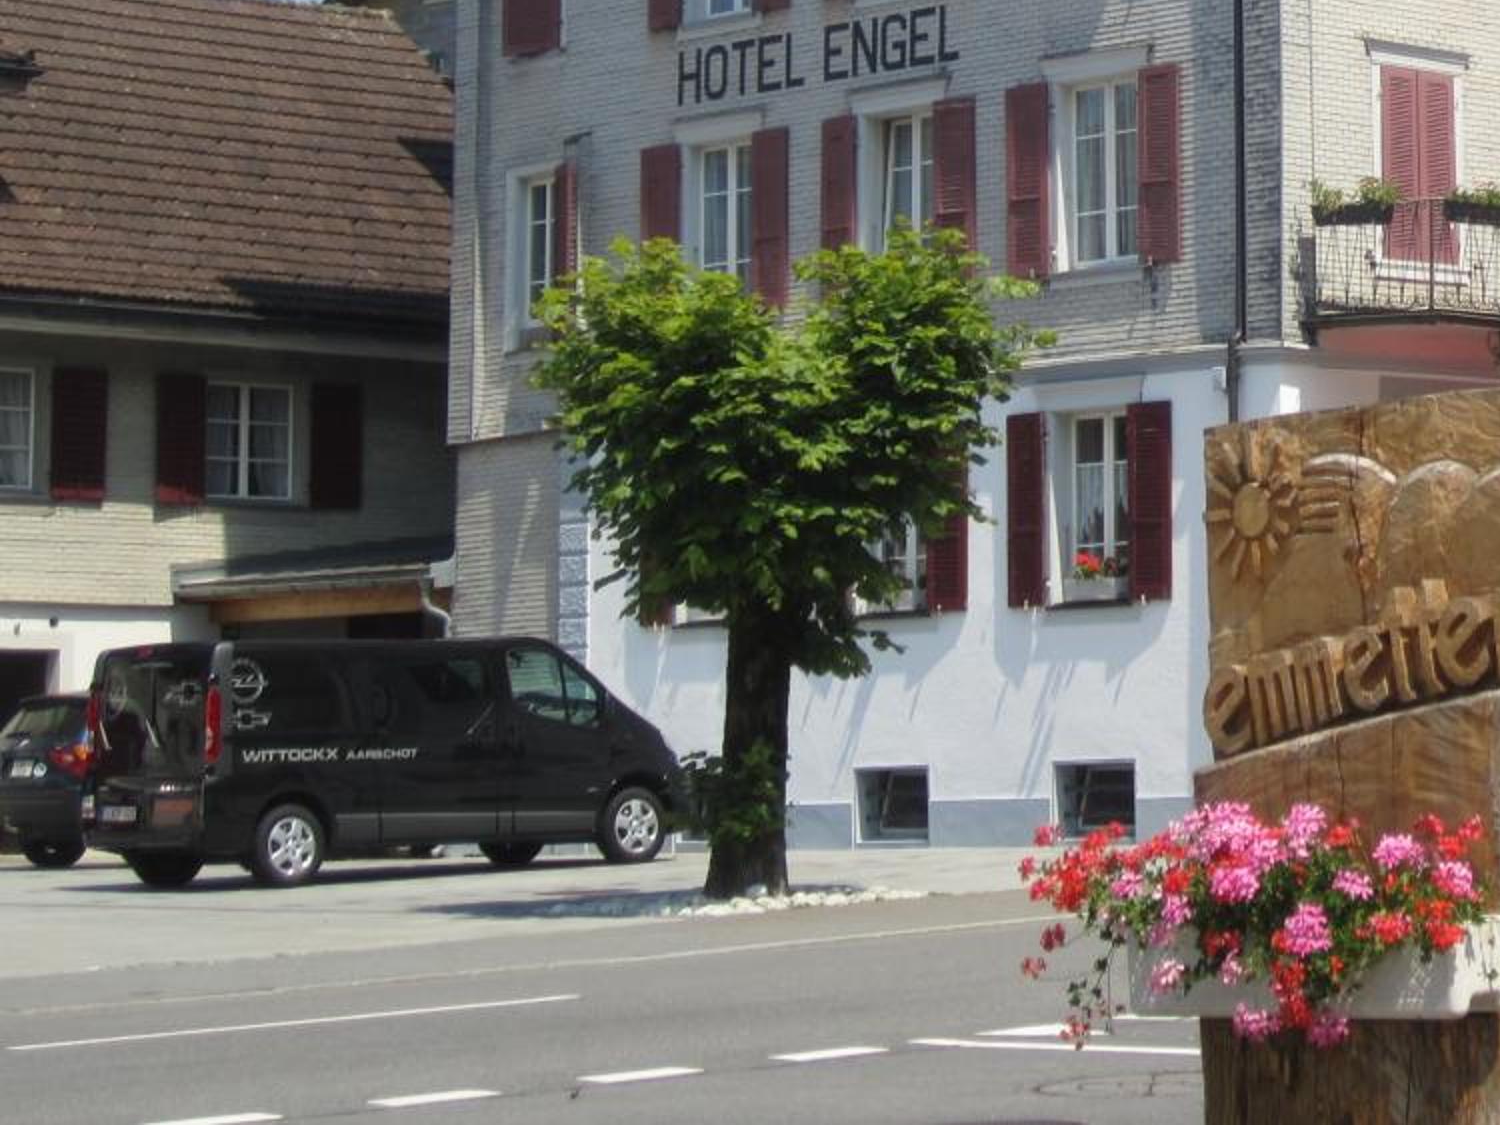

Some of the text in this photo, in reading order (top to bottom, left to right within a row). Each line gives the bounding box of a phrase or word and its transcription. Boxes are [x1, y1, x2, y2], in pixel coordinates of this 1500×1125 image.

[677, 4, 960, 106] HOTEL ENGEL
[242, 746, 339, 763] WITTOCKX
